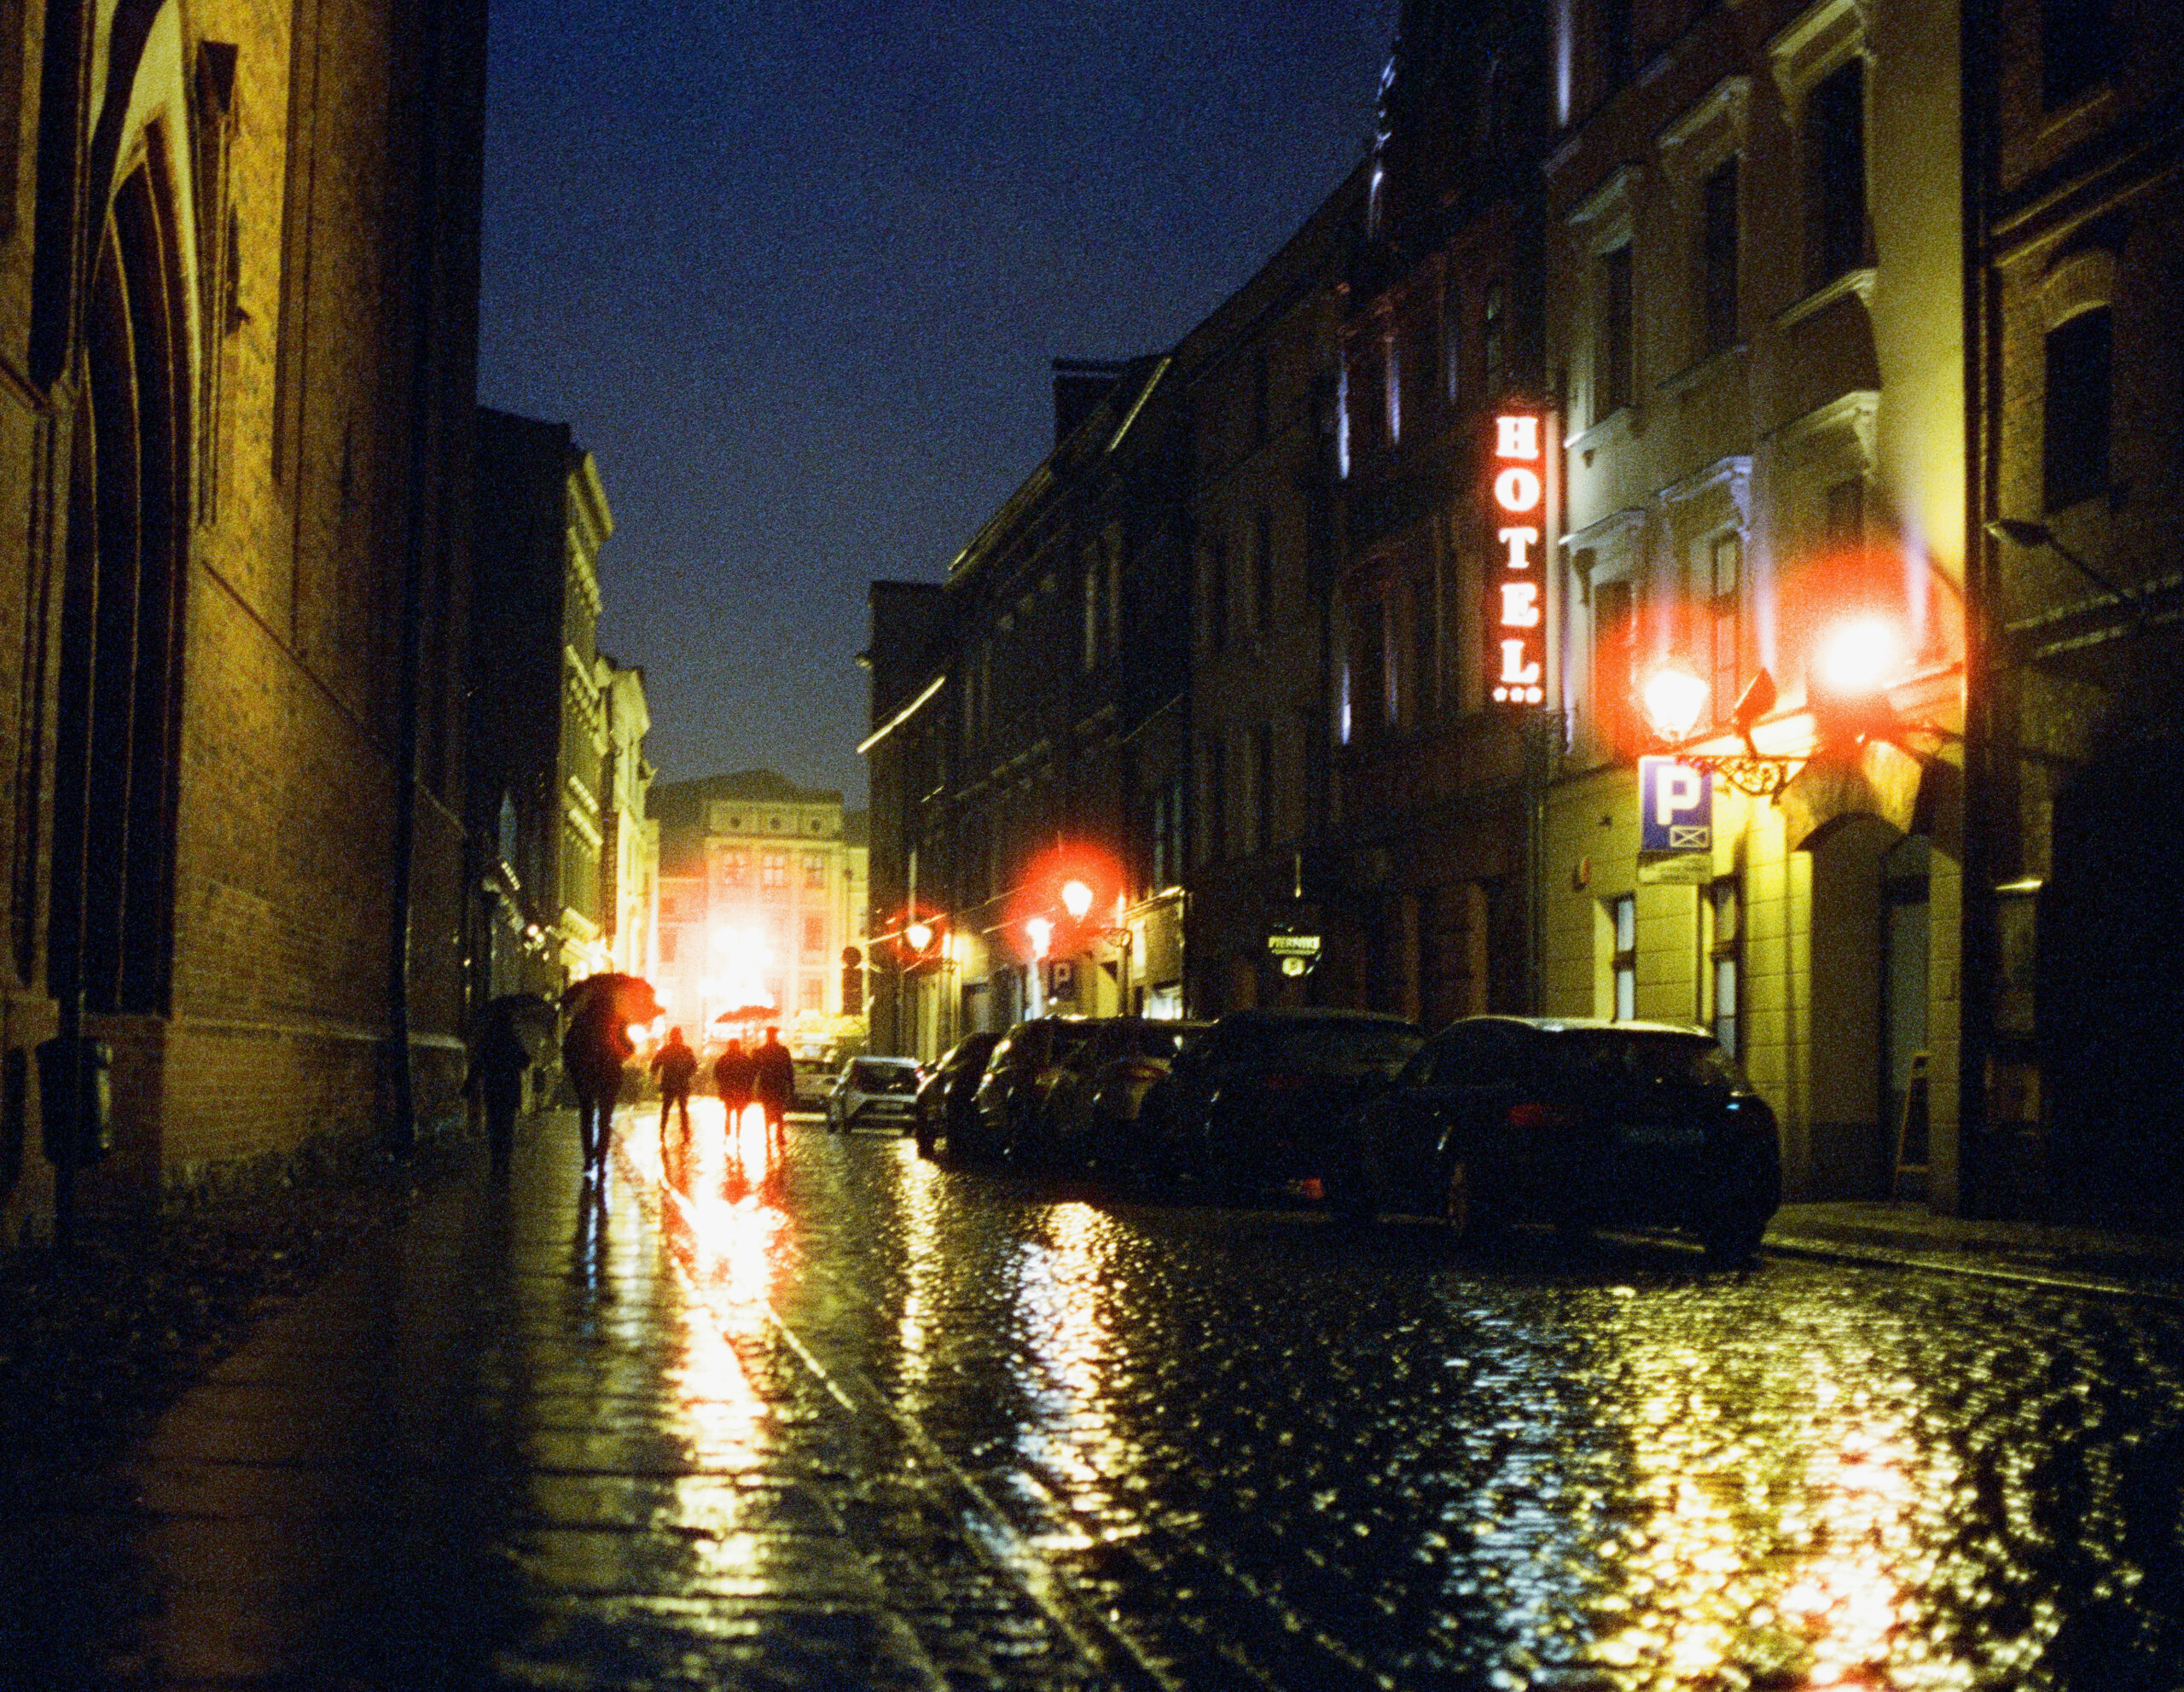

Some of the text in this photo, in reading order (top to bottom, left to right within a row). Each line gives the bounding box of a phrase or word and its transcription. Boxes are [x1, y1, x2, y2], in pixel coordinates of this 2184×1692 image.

[1495, 416, 1540, 684] HOTEL
[1656, 765, 1701, 825] P
[1054, 963, 1071, 989] P
